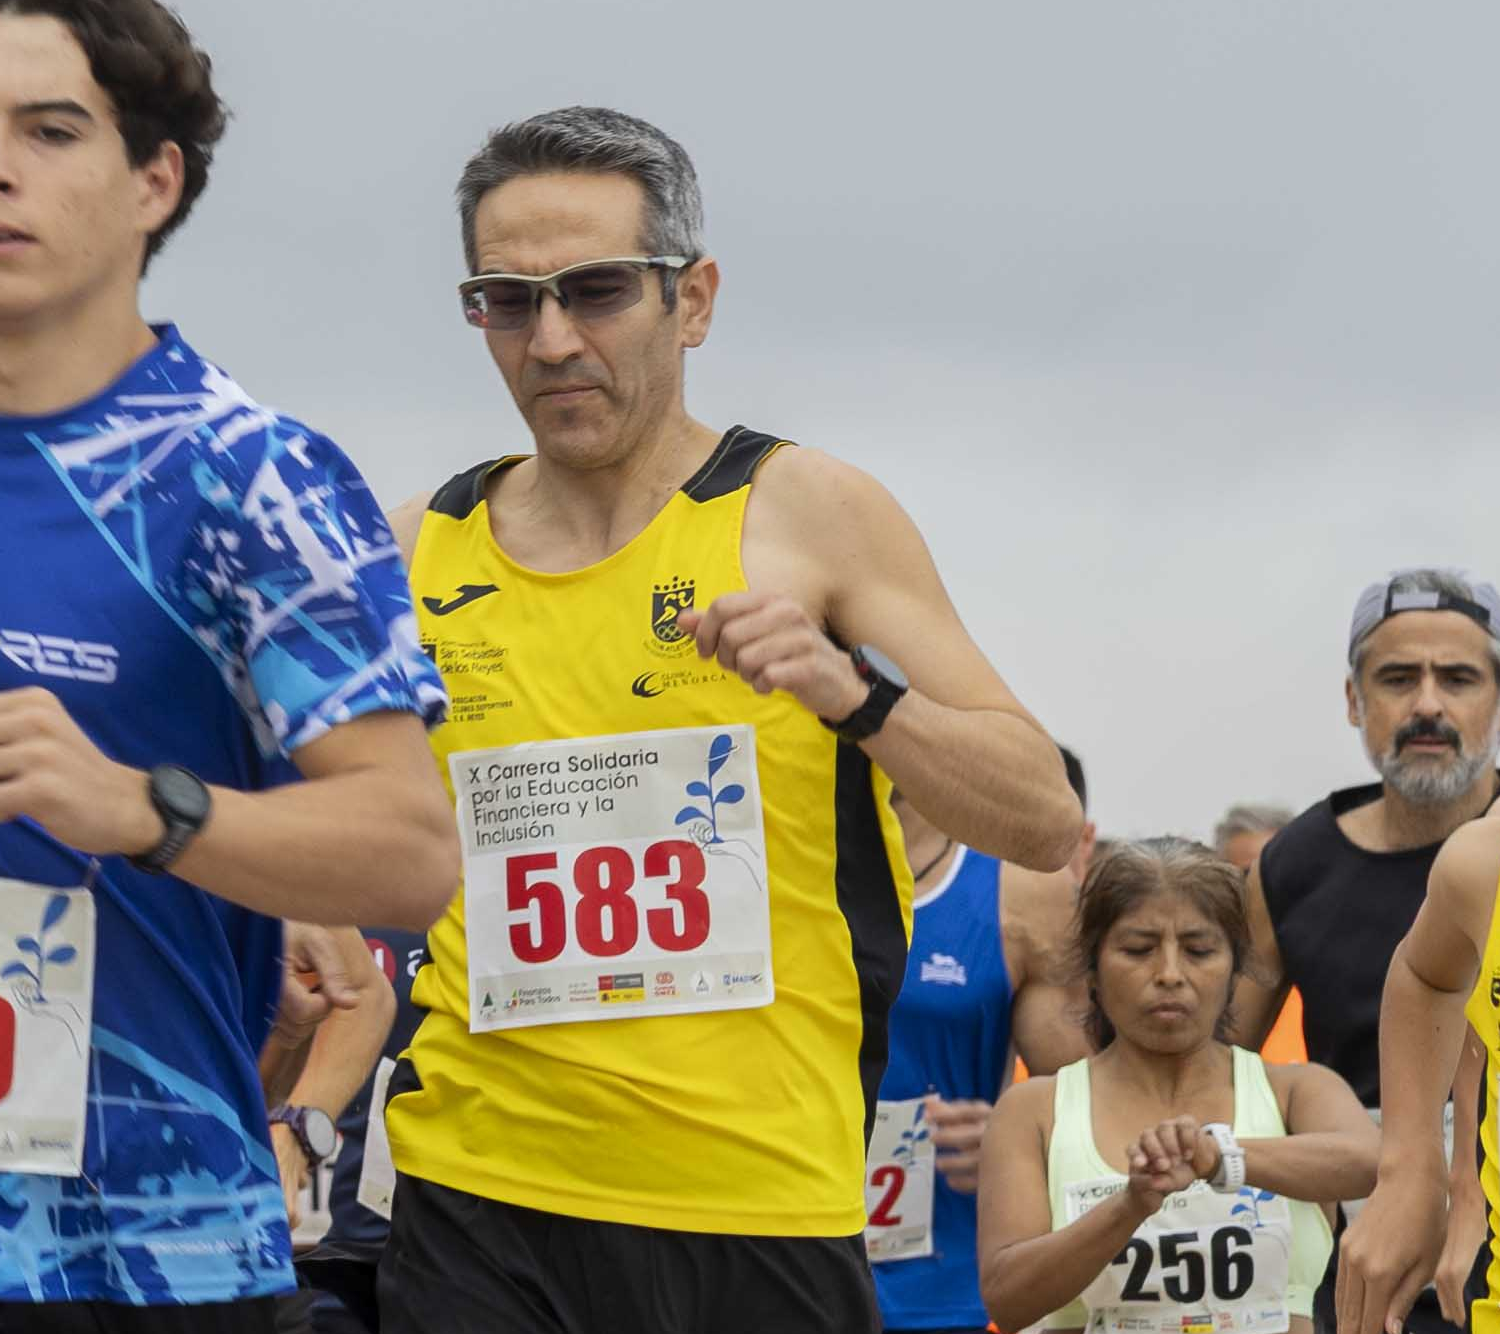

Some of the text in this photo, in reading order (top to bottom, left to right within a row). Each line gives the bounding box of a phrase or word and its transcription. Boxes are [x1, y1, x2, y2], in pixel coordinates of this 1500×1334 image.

[469, 749, 659, 784] X Carrera Solidaria
[471, 771, 639, 808] por la Educación
[473, 795, 614, 827] Financiera y la
[476, 820, 555, 847] Inclusión
[506, 838, 711, 964] 583
[1112, 1226, 1255, 1304] 256
